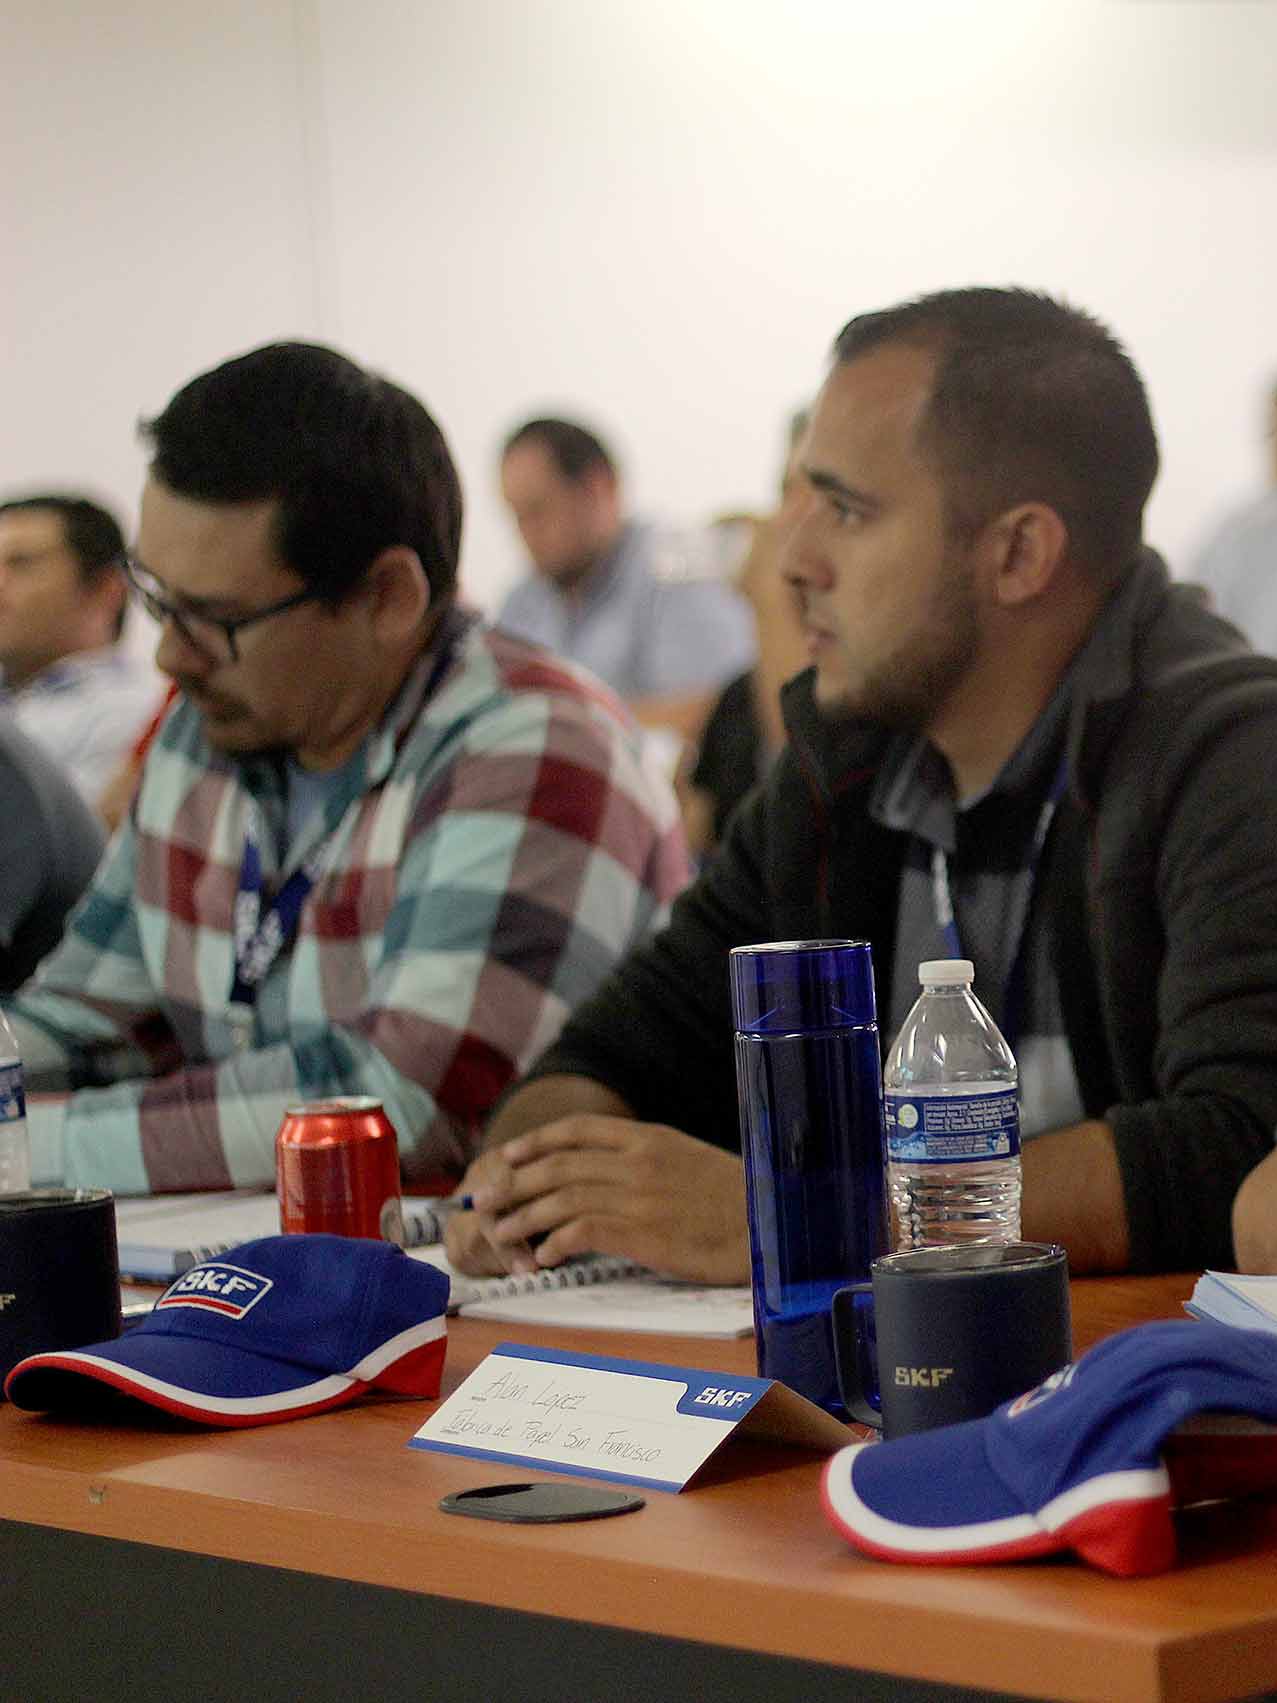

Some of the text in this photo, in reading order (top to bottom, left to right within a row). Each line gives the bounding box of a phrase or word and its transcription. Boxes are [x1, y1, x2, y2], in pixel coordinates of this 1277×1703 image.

[177, 1270, 258, 1295] SKF
[894, 1366, 953, 1387] SKF
[695, 1386, 753, 1409] SKF
